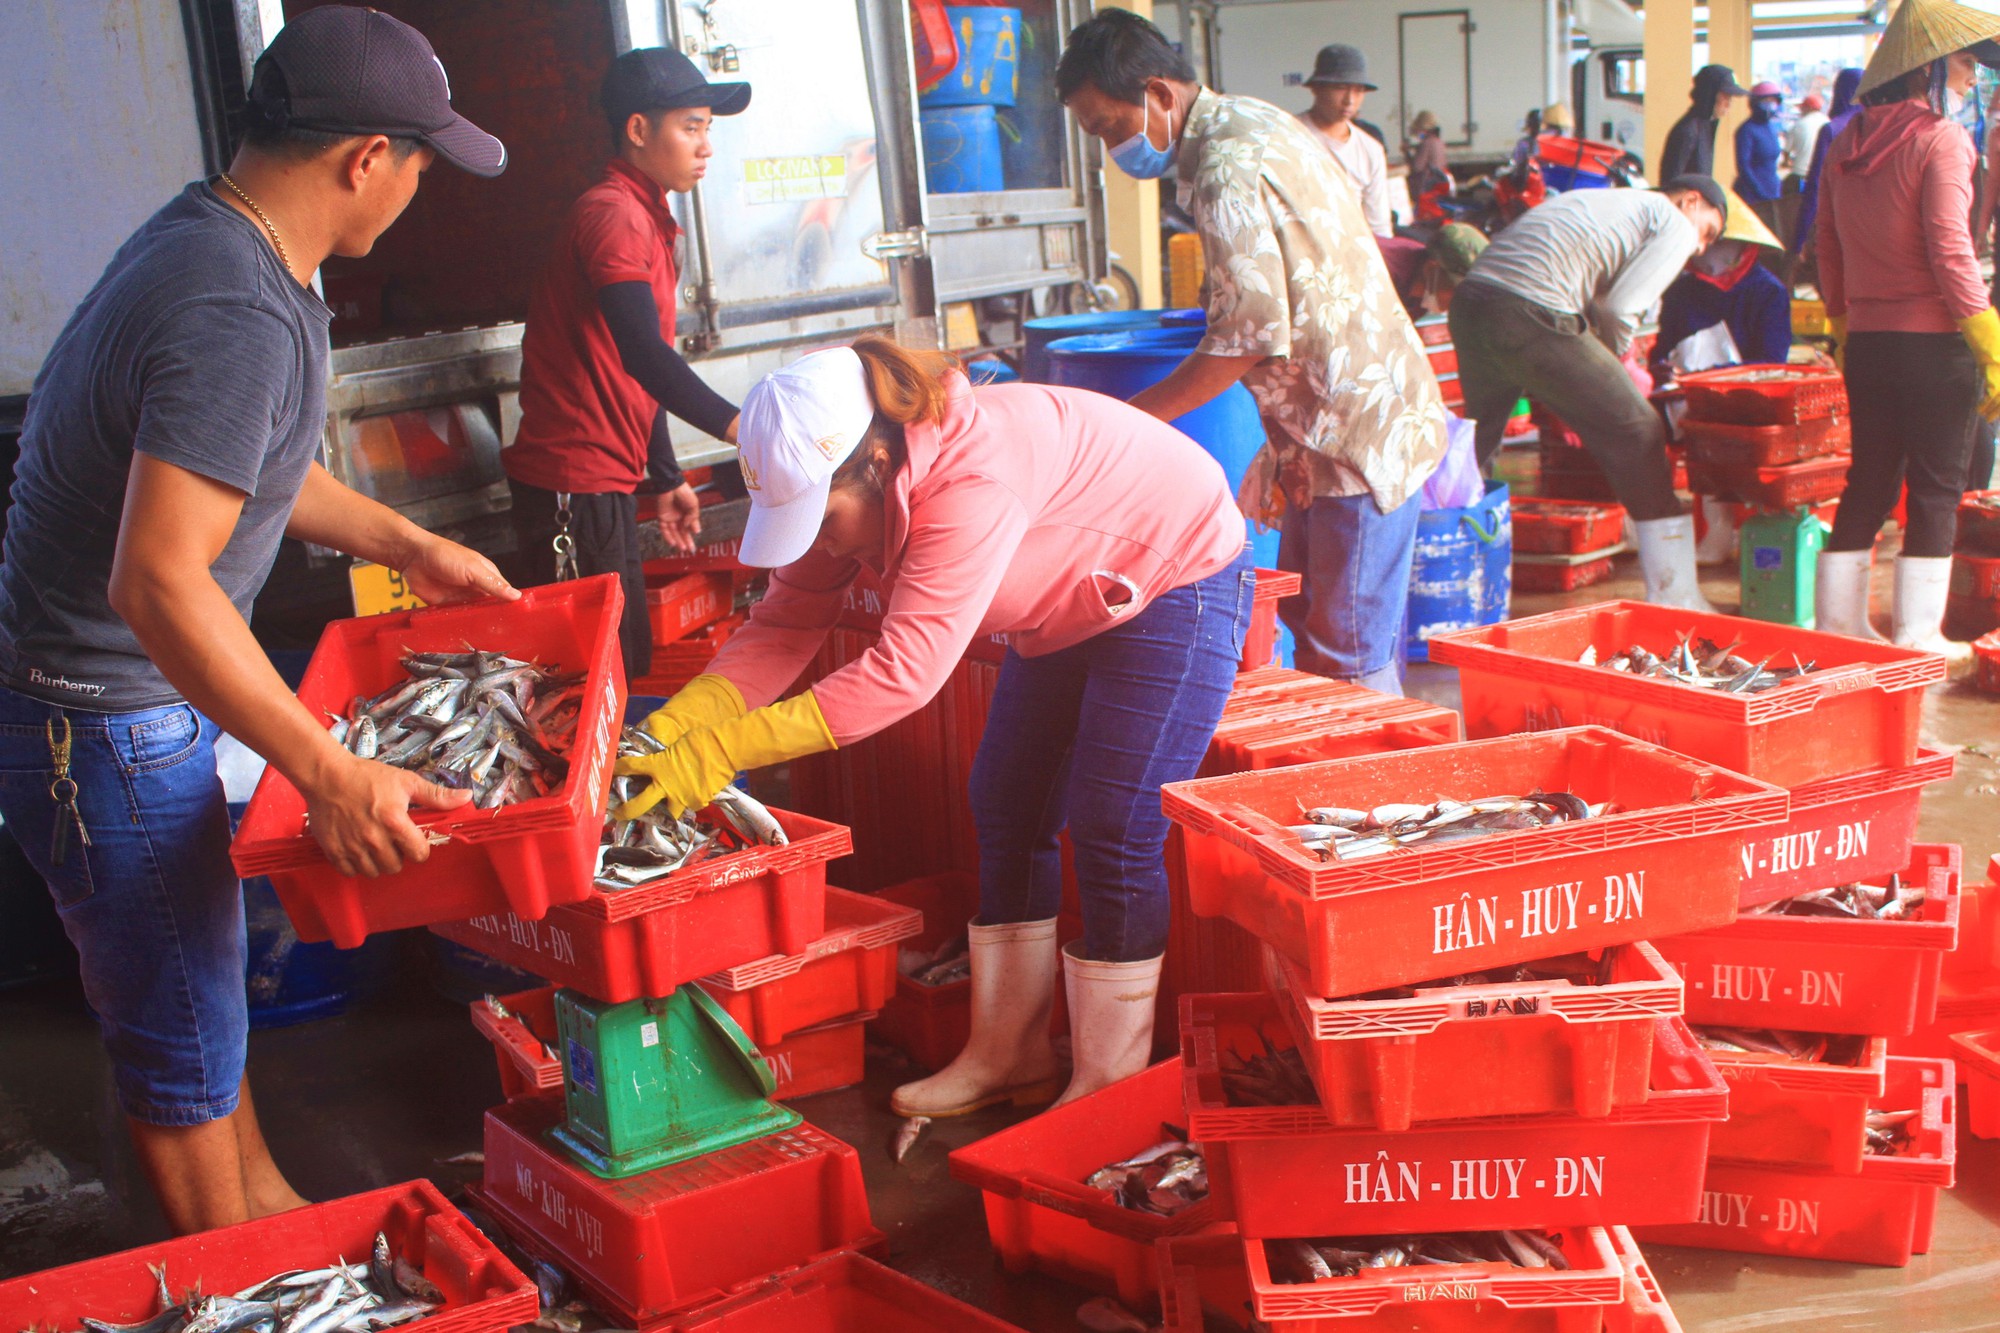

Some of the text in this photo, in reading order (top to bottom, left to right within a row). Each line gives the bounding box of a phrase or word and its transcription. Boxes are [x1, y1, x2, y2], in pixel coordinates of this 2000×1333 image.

[30, 667, 106, 697] Burberry
[1770, 829, 1822, 874] HUY
[1836, 820, 1871, 861] ĐN
[1432, 891, 1498, 954] HÂN
[1520, 880, 1583, 939] HUY
[1603, 870, 1646, 924] ĐN
[1467, 996, 1540, 1018] HAN
[1711, 963, 1776, 1002] HUY
[1800, 970, 1844, 1008] ĐN
[1344, 1150, 1423, 1204] HÂN
[1450, 1158, 1527, 1201] HUY
[1553, 1156, 1606, 1198] ĐN
[1776, 1197, 1820, 1236] ĐN
